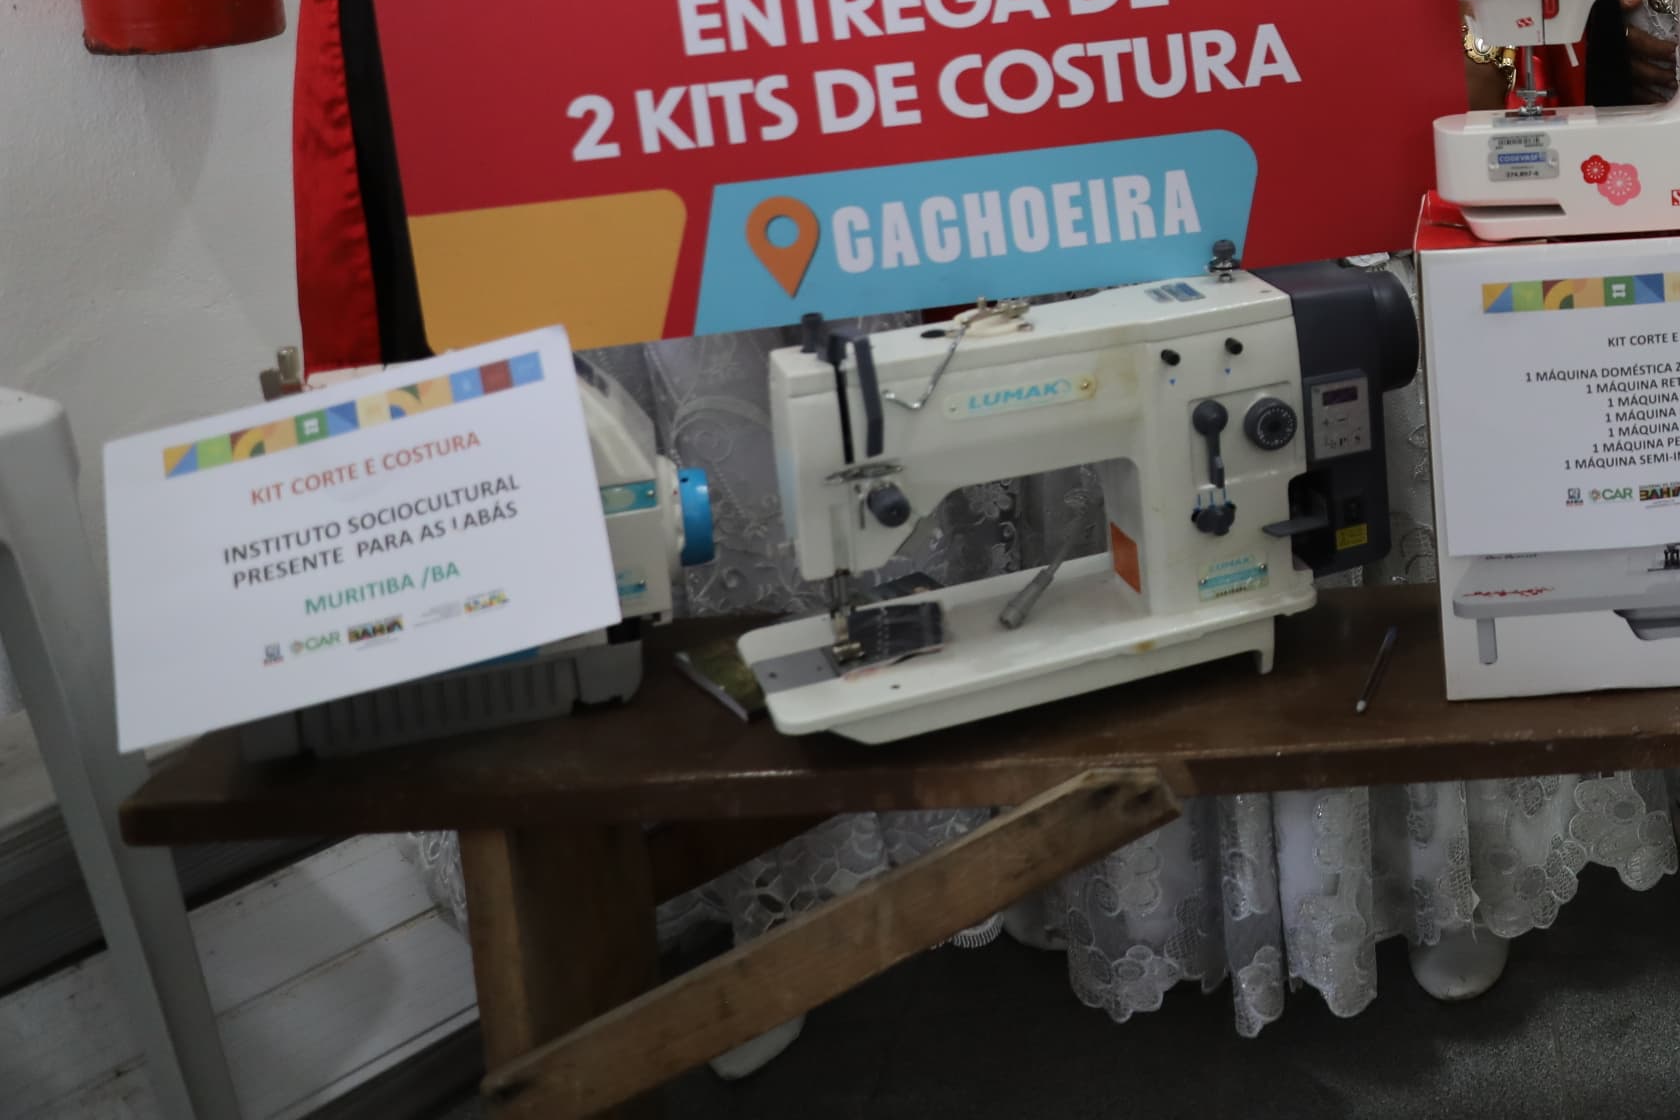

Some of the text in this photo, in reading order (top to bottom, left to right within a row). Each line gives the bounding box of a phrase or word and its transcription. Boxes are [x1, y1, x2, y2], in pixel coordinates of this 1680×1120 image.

[566, 23, 1301, 162] 2 KITS DE COSTURA
[832, 169, 1201, 274] CACHOEIRA
[1608, 336, 1626, 347] KIT
[1630, 333, 1668, 346] CORTE
[1672, 332, 1678, 343] E
[1526, 372, 1532, 382] 1
[1536, 366, 1598, 381] MÁQUINA
[1602, 363, 1672, 378] DOMÉSTICA
[1587, 384, 1593, 394] 1
[1596, 378, 1658, 393] MÁQUINA
[968, 381, 1058, 411] LUMAK
[1608, 398, 1614, 407] 1
[1618, 392, 1679, 407] MÁQUINA
[1606, 413, 1612, 422] 1
[1616, 406, 1677, 422] MÁQUINA
[1609, 428, 1615, 437] 1
[1618, 421, 1679, 437] MÁQUINA
[1593, 444, 1599, 453] 1
[1603, 437, 1664, 452] MÁQUINA
[251, 432, 480, 505] KIT CORTE E COSTURA
[1565, 460, 1571, 470] 1
[1575, 454, 1637, 469] MÁQUINA
[1602, 488, 1633, 500] CAR
[224, 474, 519, 564] INSTITUTO SOCIOCULTURAL
[233, 546, 344, 589] PRESENTE
[356, 530, 414, 558] PARA
[420, 520, 446, 542] AS
[305, 574, 414, 615] MURITIBA
[421, 562, 460, 590] /BA
[304, 630, 341, 651] CAR
